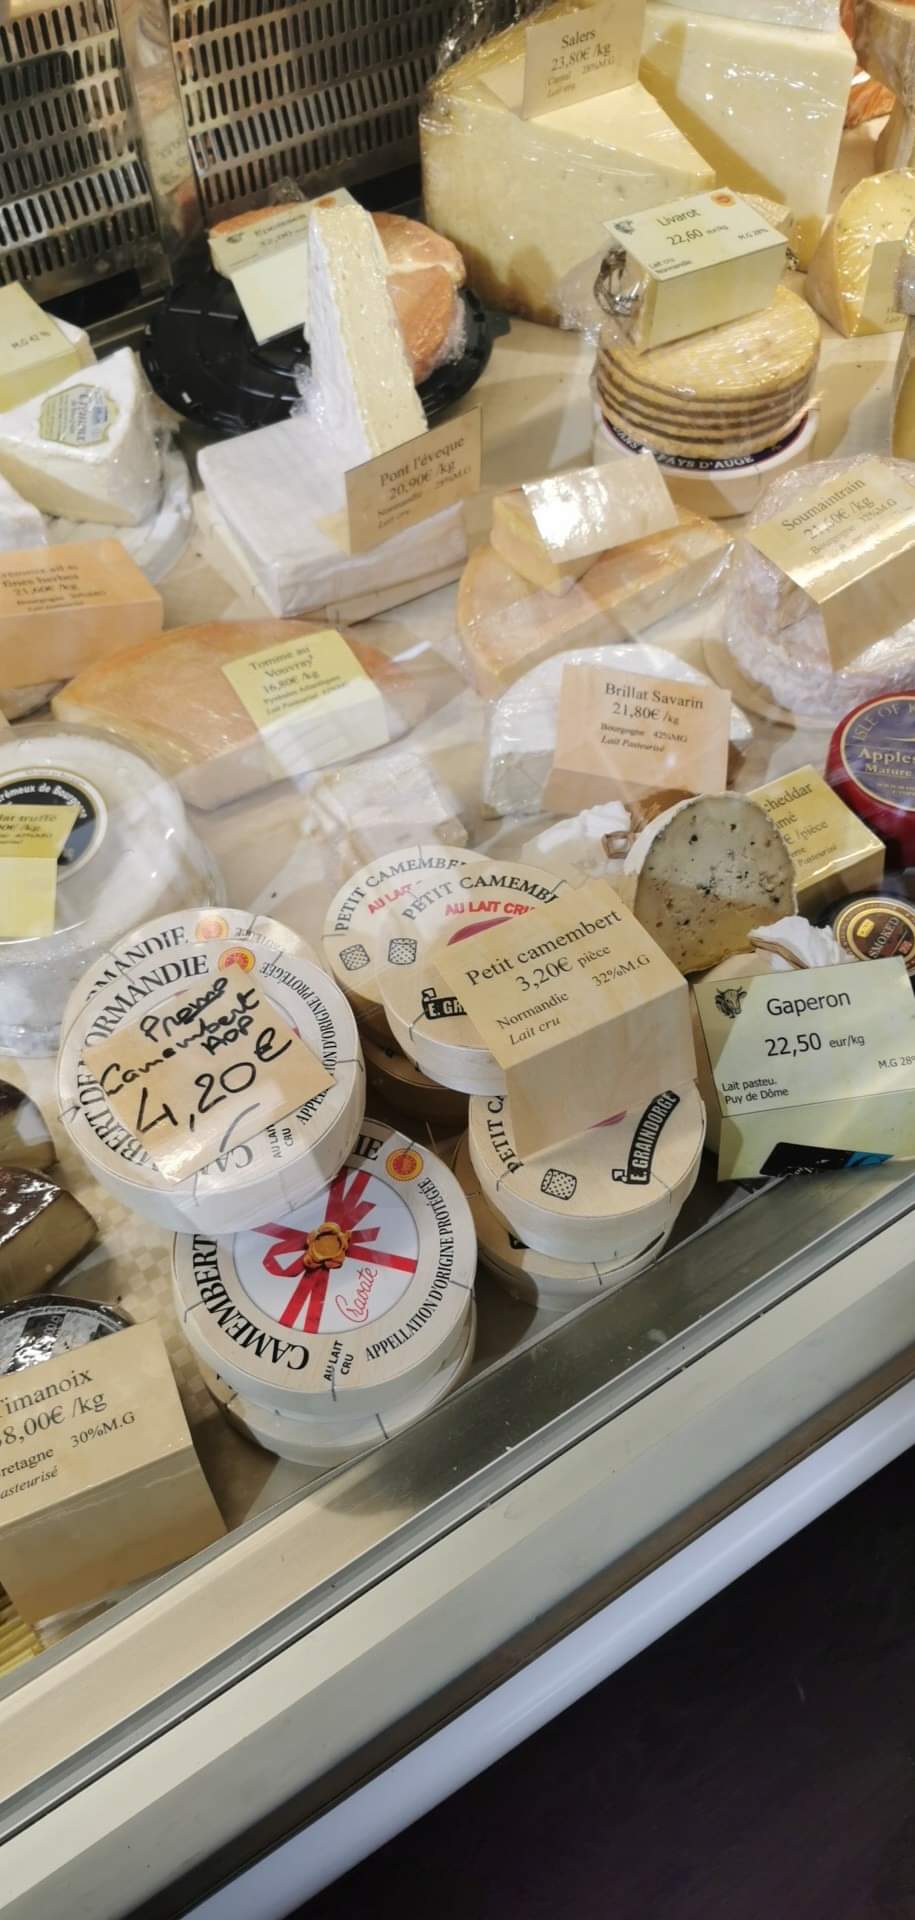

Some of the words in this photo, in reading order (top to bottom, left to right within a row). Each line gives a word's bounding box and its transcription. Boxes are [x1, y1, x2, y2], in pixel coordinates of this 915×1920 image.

[561, 30, 596, 48] Salers
[656, 209, 701, 227] Livarot
[666, 228, 704, 246] 22,60
[380, 464, 409, 487] Pont
[658, 455, 695, 469] PAYS
[699, 455, 755, 471] D'AUGE
[782, 479, 867, 532] Soumaintrain
[248, 652, 293, 671] Tomme
[605, 682, 649, 701] Brillat
[652, 690, 704, 710] Savarin
[612, 702, 661, 721] 21,80€
[663, 711, 680, 726] /kg
[601, 736, 620, 746] Lait
[865, 763, 913, 777] Mature
[335, 886, 366, 933] PETIT
[366, 857, 467, 888] CAMEMBE
[367, 897, 386, 915] AU
[402, 881, 453, 921] PETIT
[445, 903, 465, 916] AU
[469, 901, 501, 913] LAIT
[465, 957, 514, 986] Petit
[516, 909, 623, 964] camembert
[869, 916, 900, 959] SMOKED
[87, 925, 188, 1002] MANDIE
[515, 956, 573, 992] 3,20€
[496, 992, 569, 1030] Normandie
[591, 953, 651, 987] 32%M.G
[766, 991, 852, 1017] Gaperon
[79, 954, 209, 1065] ORMANDIE
[201, 1014, 254, 1056] AOP
[509, 1027, 537, 1046] Lait
[539, 1016, 561, 1033] cru
[764, 1032, 823, 1058] 22,50
[828, 1033, 866, 1049] eur/kg
[877, 1057, 898, 1070] M.G
[721, 1080, 741, 1092] Lait
[742, 1077, 778, 1092] pasteu.
[724, 1094, 744, 1105] Puy
[745, 1090, 759, 1102] de
[760, 1087, 790, 1100] Dôme
[281, 1127, 295, 1148] CRU
[486, 1118, 525, 1174] PETIT
[632, 1091, 679, 1171] GRAINDORGE
[416, 1176, 454, 1237] PROTÉGÉE
[427, 1236, 455, 1303] D'ORIGINE
[191, 1233, 310, 1371] CAMEMBERT
[365, 1298, 440, 1362] APPELLATION
[323, 1363, 336, 1382] AU
[330, 1340, 344, 1365] LAIT
[340, 1353, 355, 1376] CRU
[0, 1369, 93, 1419] imanoix
[0, 1405, 66, 1447] 8,00€
[72, 1392, 108, 1418] /kg
[0, 1448, 54, 1478] retagne
[71, 1411, 136, 1448] 30%M.G
